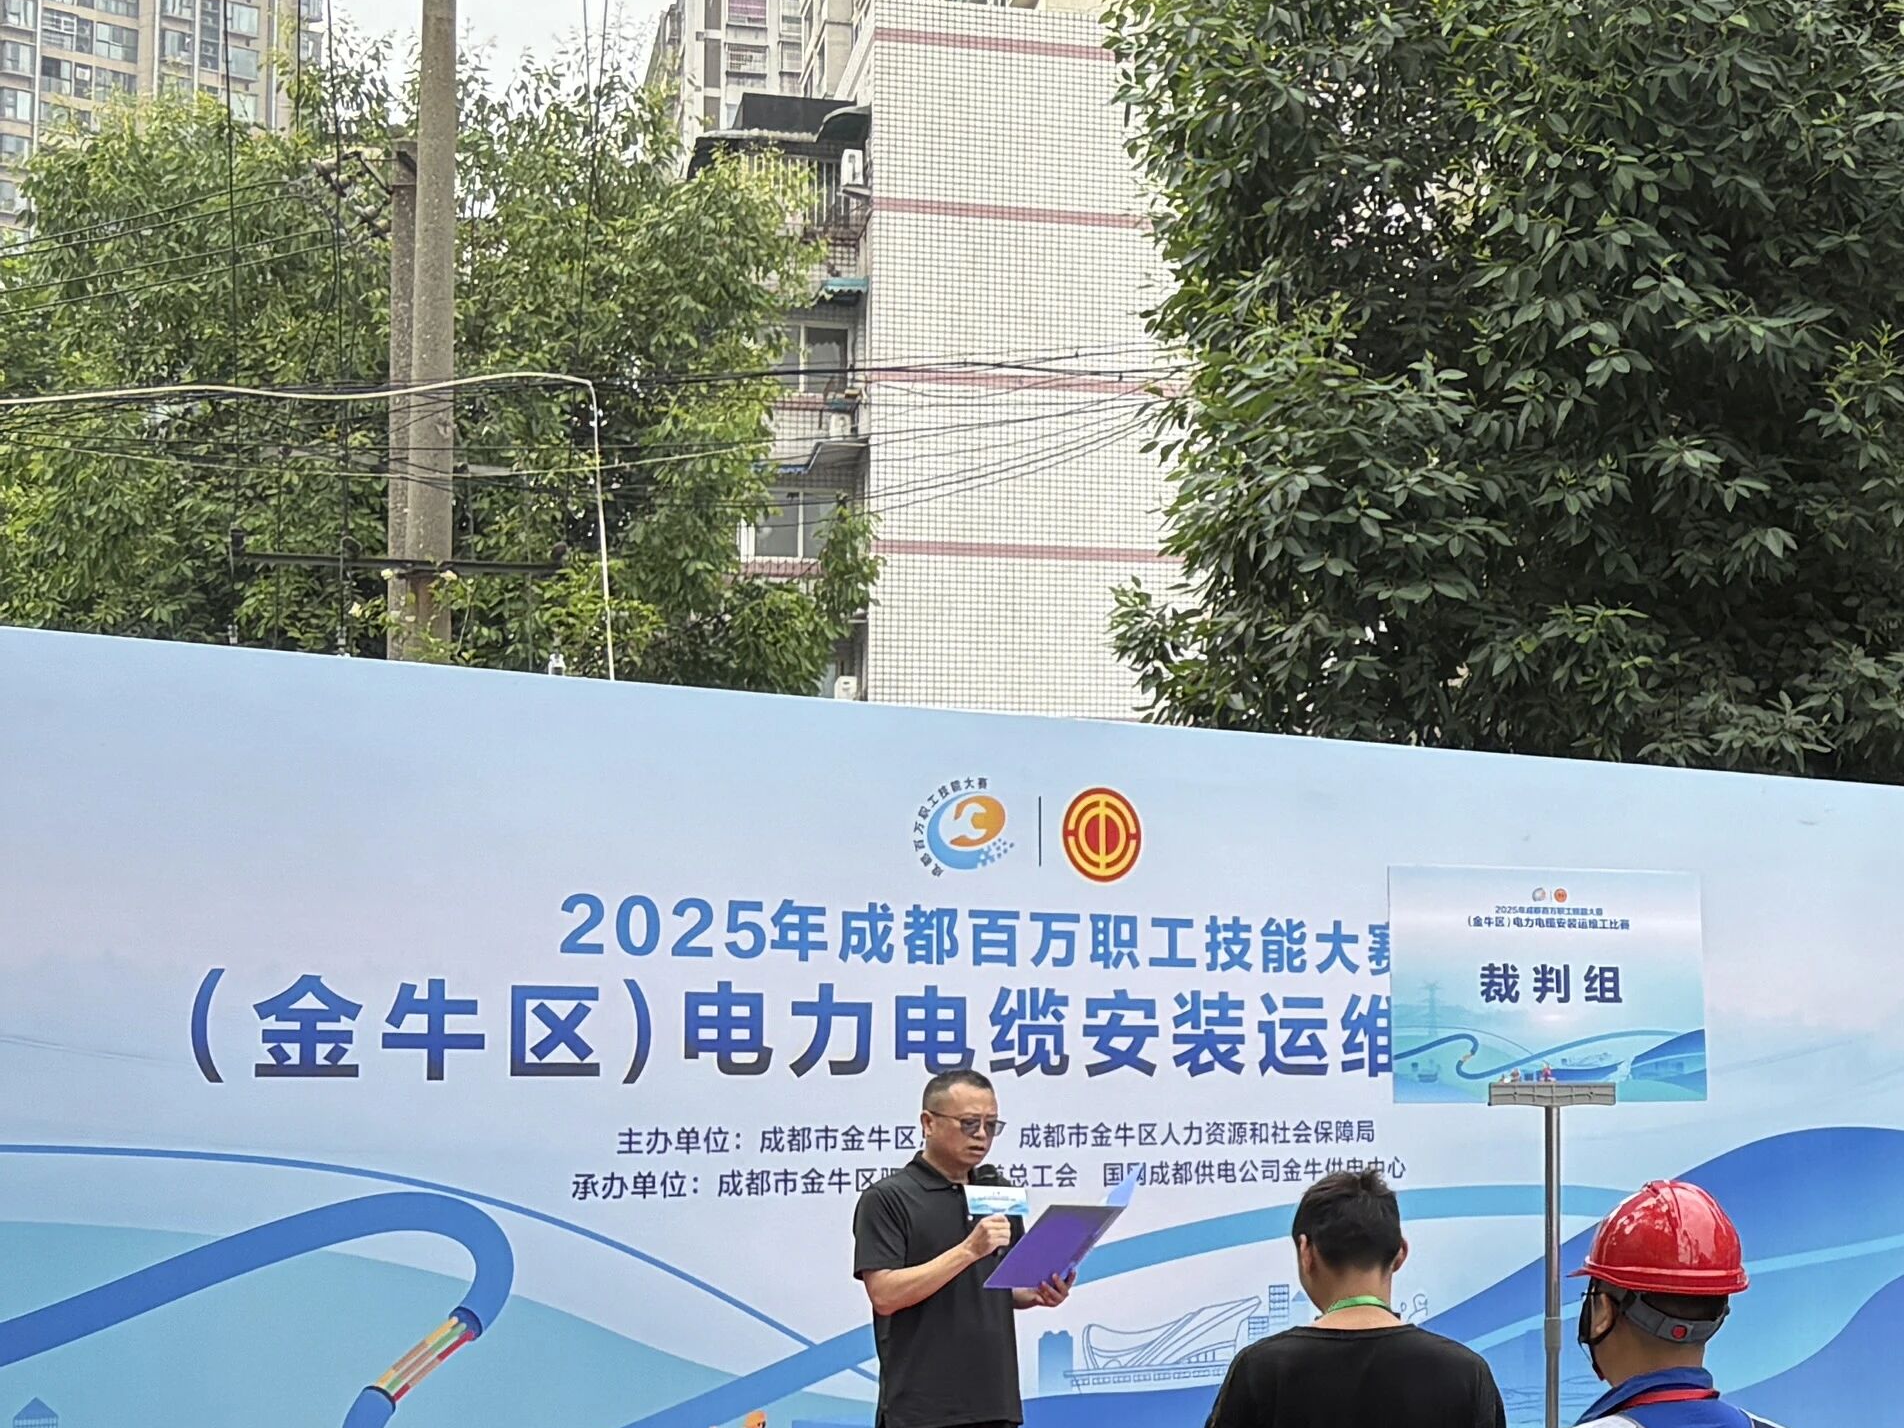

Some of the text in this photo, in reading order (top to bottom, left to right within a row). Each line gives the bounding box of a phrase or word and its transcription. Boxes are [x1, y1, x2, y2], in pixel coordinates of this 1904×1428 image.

[1479, 962, 1623, 1005] 裁判组
[1019, 1120, 1376, 1149] 成都市金牛区人力资源和社会保障局
